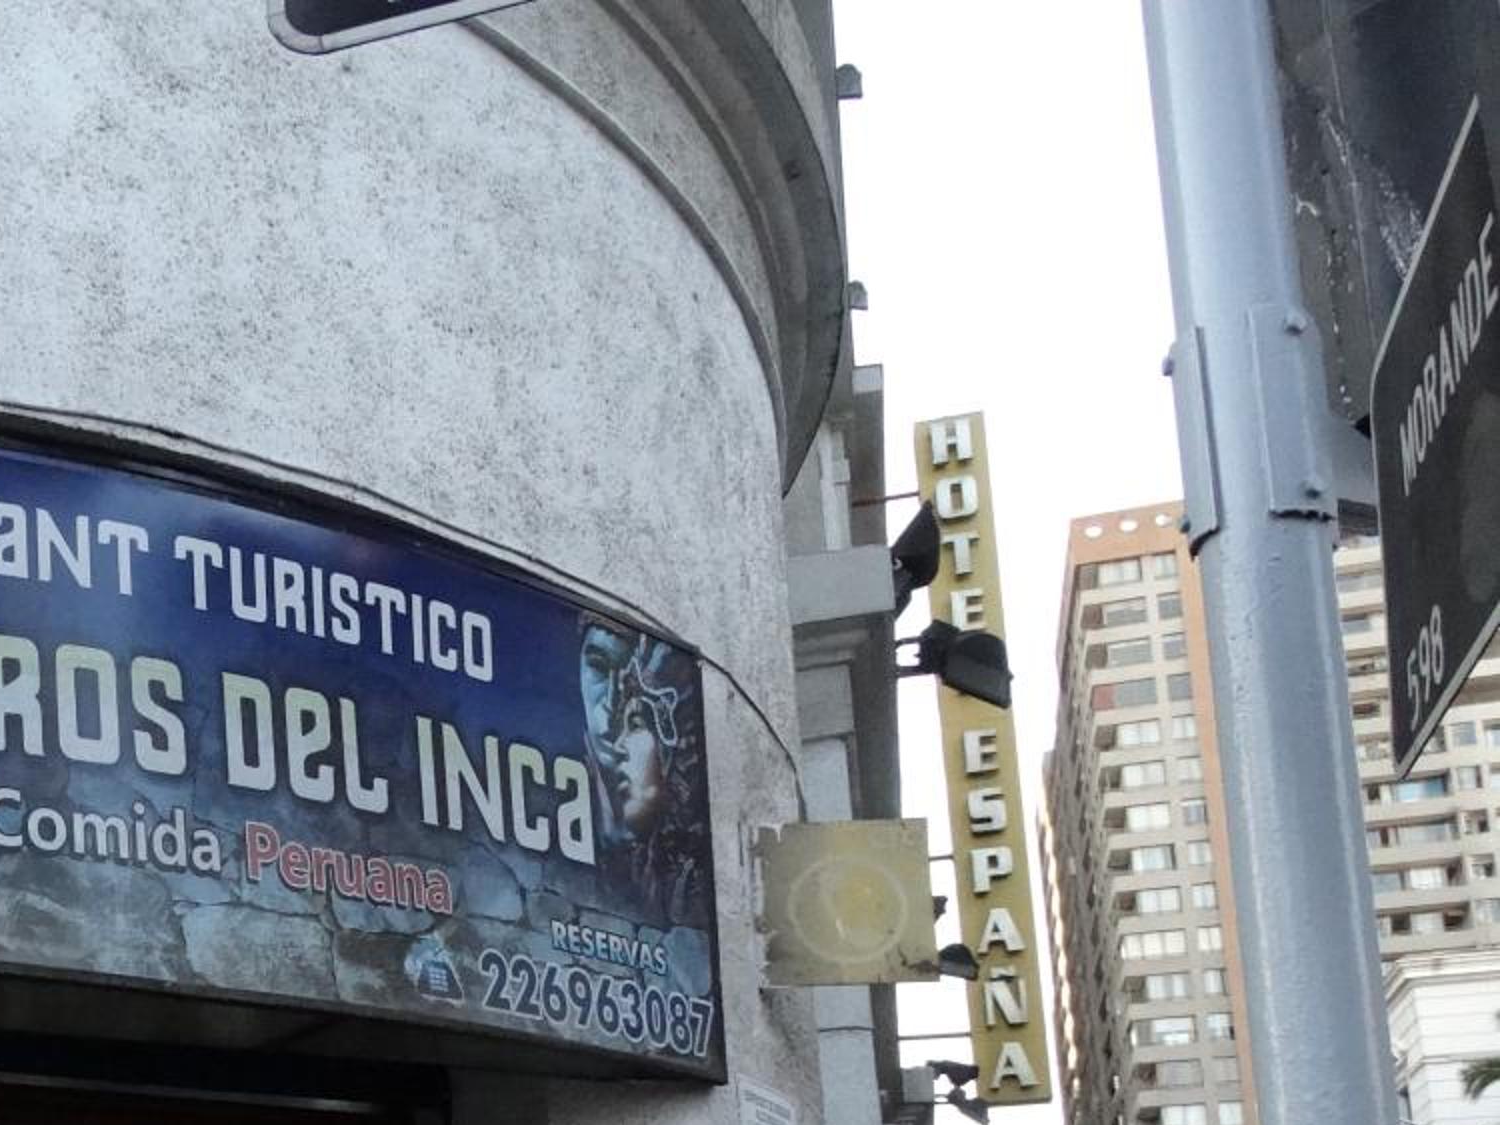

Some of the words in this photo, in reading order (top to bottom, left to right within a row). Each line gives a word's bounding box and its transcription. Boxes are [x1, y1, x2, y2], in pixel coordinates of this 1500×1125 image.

[1400, 212, 1499, 496] MORANDE
[173, 535, 495, 684] TURISTICO
[1406, 605, 1446, 732] 598
[930, 418, 992, 650] HOTE
[963, 728, 1041, 1091] ESPAÑA
[244, 820, 455, 916] Peruana
[478, 948, 714, 1058] 226963087
[551, 919, 668, 976] RESERVAS
